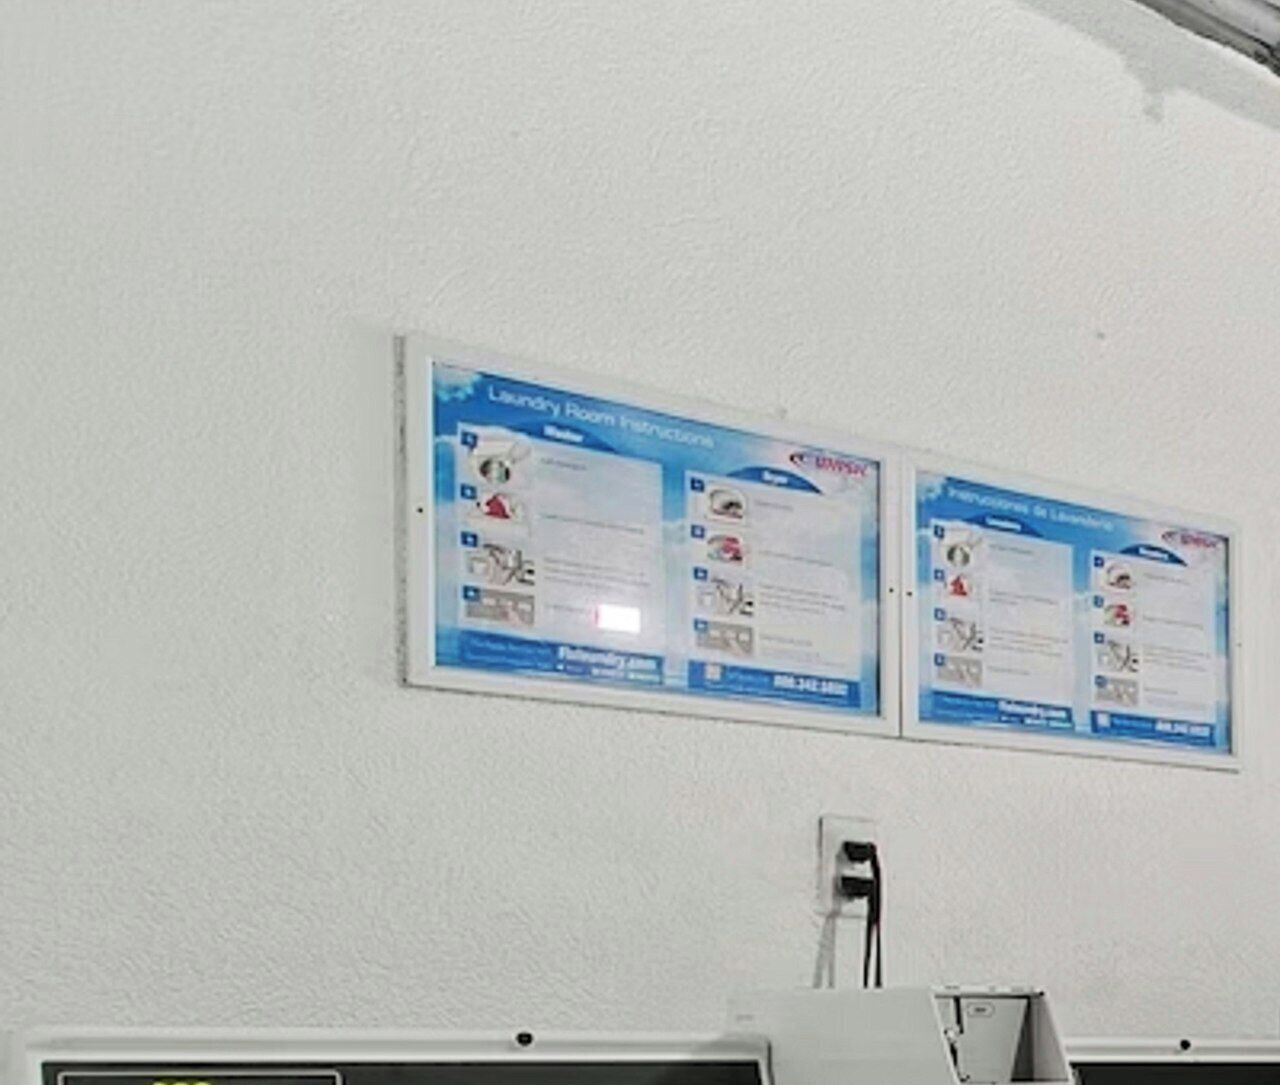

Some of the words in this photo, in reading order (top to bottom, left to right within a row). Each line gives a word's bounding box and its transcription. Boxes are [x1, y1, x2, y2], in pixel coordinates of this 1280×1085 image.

[488, 385, 561, 417] Laundry
[565, 401, 615, 427] Room
[618, 414, 714, 449] Instructions
